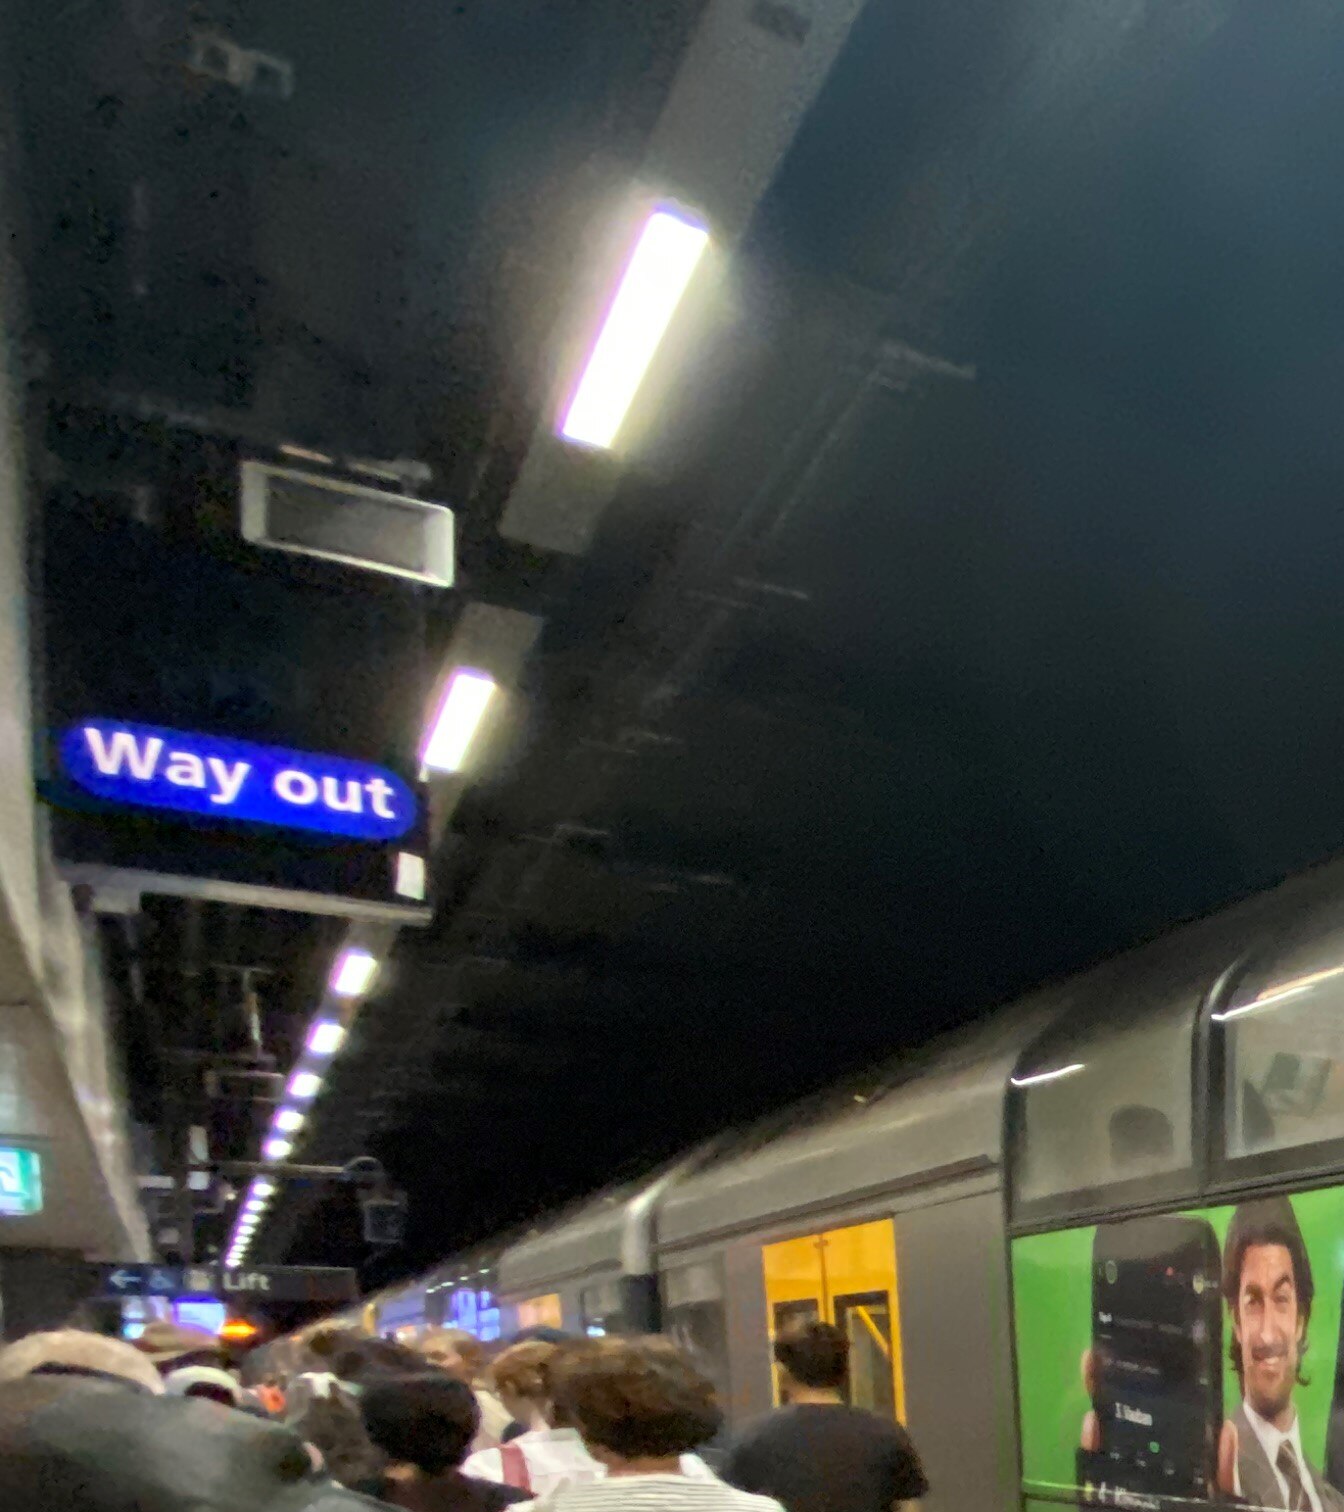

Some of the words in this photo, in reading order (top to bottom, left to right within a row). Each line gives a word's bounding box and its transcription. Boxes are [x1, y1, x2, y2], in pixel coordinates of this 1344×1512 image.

[84, 727, 250, 804] Way
[274, 769, 395, 819] out
[223, 1271, 270, 1292] Lift
